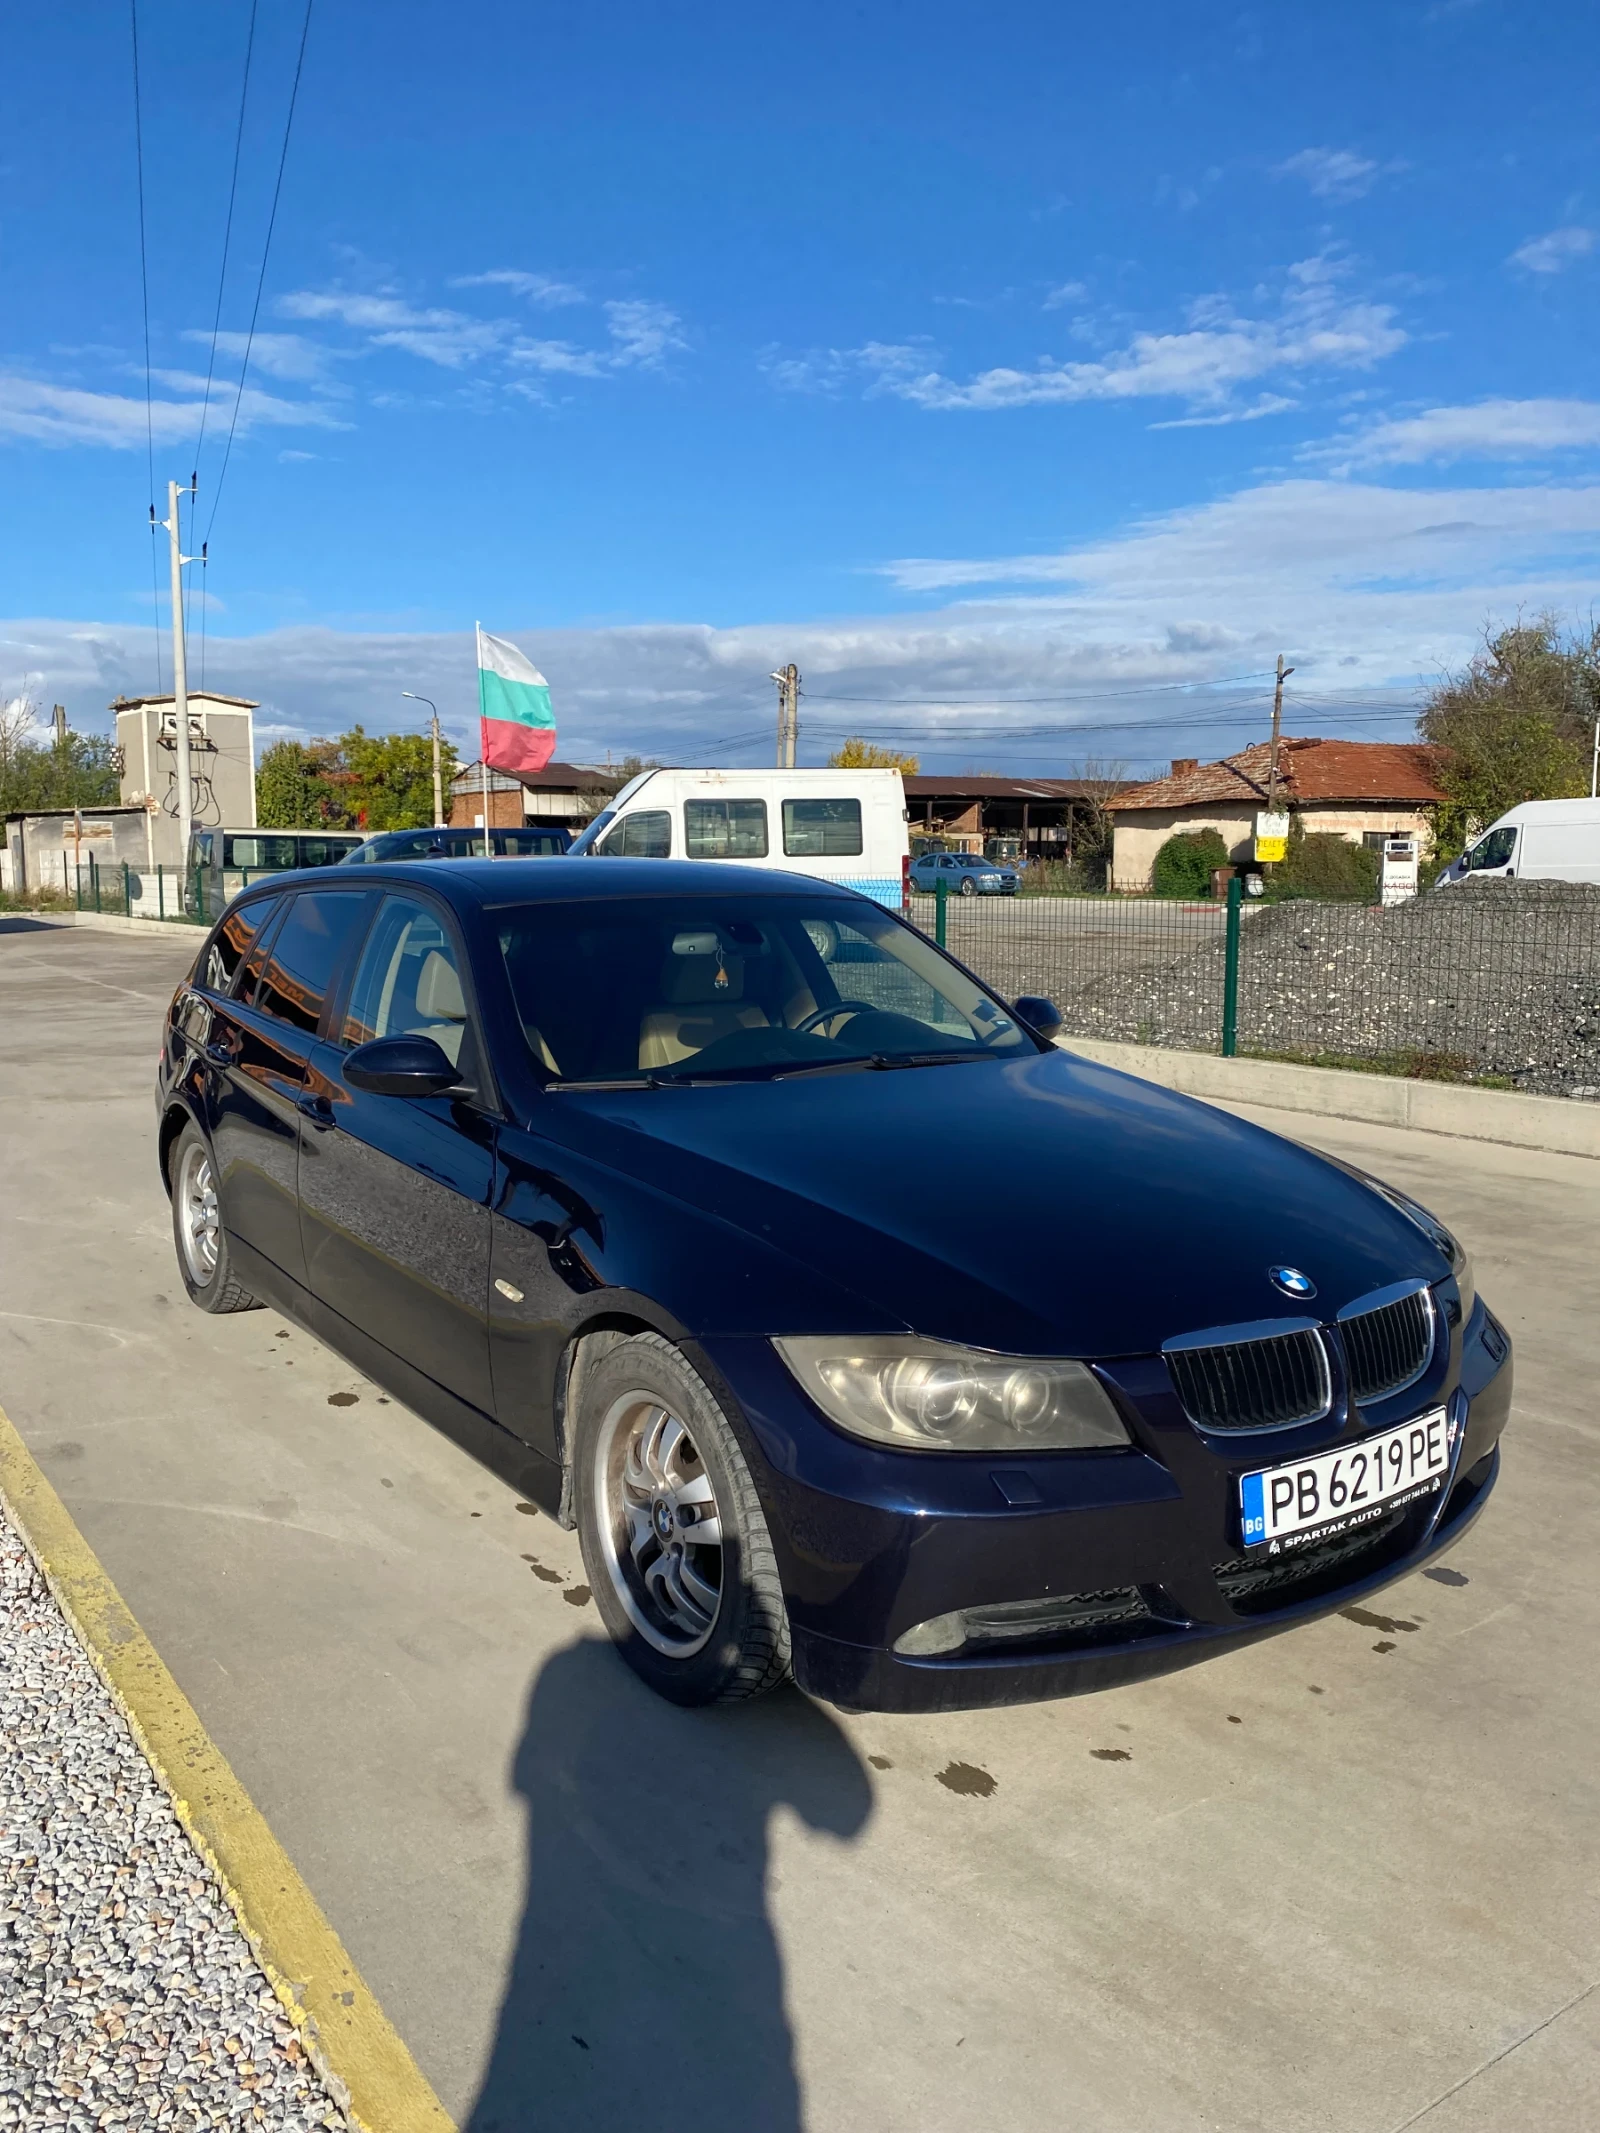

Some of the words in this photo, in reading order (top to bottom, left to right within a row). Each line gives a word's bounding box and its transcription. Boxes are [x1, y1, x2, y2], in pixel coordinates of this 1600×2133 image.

[1271, 1469, 1320, 1527] PB
[1329, 1439, 1404, 1508] 6219
[1410, 1419, 1443, 1478] PE
[1246, 1516, 1263, 1535] BG
[1284, 1520, 1347, 1548] SPARTAK
[1349, 1507, 1382, 1527] AUTO
